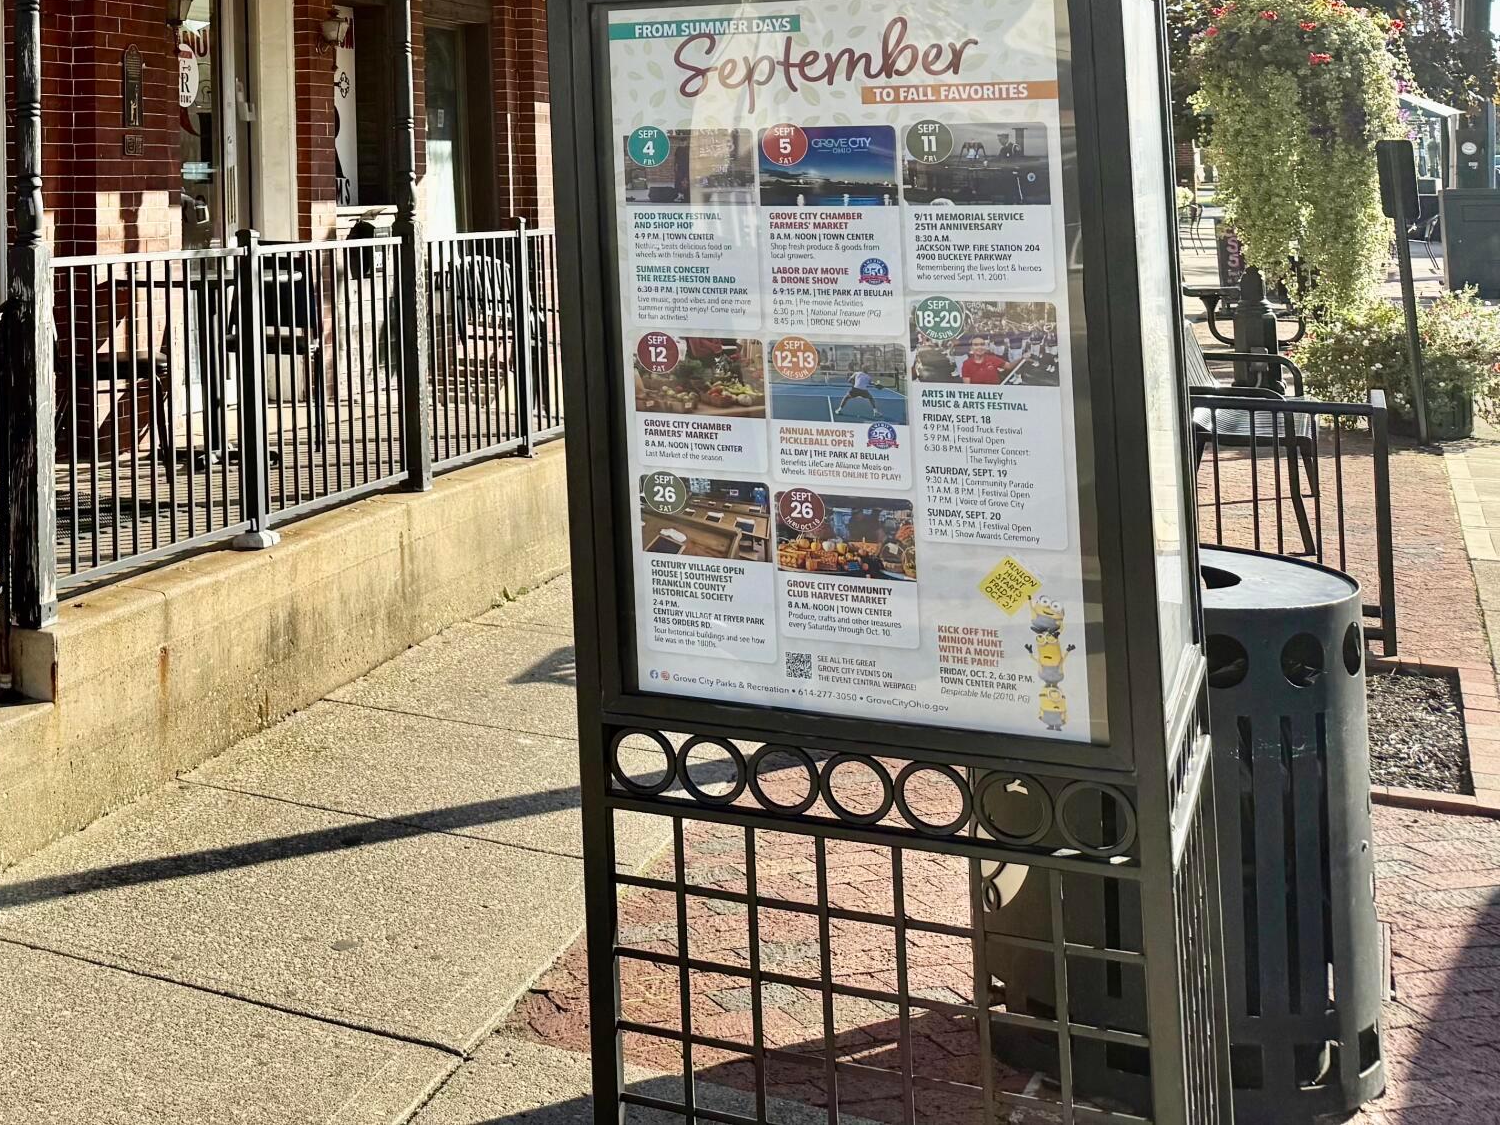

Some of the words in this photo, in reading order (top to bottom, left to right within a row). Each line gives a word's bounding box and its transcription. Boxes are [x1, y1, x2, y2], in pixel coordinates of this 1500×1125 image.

[635, 23, 677, 38] FROM
[681, 20, 748, 35] SUMMER
[752, 18, 791, 32] DAYS
[674, 16, 979, 114] September
[873, 88, 895, 102] TO
[900, 86, 936, 101] FALL
[940, 83, 1028, 100] FAVORITES
[638, 129, 658, 138] SEPT
[774, 127, 795, 136] SEPT
[917, 124, 940, 134] SEPT
[642, 140, 655, 156] 4
[779, 138, 792, 154] 5
[921, 136, 937, 152] 11
[769, 212, 798, 220] GROVE
[799, 212, 818, 220] CITY
[820, 212, 863, 220] CHAMBER
[914, 213, 933, 221] 9/11
[936, 213, 985, 221] MEMORIAL
[987, 213, 1024, 221] SERVICE
[813, 222, 849, 230] MARKET
[915, 223, 937, 231] 25TH
[940, 223, 1003, 231] ANNIVERSARY
[915, 244, 951, 252] JACKSON
[953, 244, 971, 252] TWP.
[673, 266, 710, 274] CONCERT
[771, 267, 800, 275] LABOR
[802, 267, 818, 275] DAY
[821, 267, 849, 276] MOVIE
[916, 264, 965, 272] Remembering
[1018, 264, 1042, 272] heroes
[772, 276, 778, 284] &
[780, 276, 810, 284] DRONE
[812, 277, 839, 285] SHOW
[927, 300, 950, 310] SEPT
[916, 310, 960, 328] 18-20
[647, 336, 668, 345] SEPT
[784, 341, 805, 350] SEPT
[649, 347, 667, 362] 12
[774, 351, 815, 368] 12-13
[921, 389, 944, 398] ARTS
[946, 390, 955, 398] IN
[958, 391, 975, 399] THE
[977, 391, 1003, 400] ALLEY
[922, 400, 951, 408] MUSIC
[953, 401, 960, 409] &
[962, 401, 985, 410] ARTS
[987, 402, 1028, 411] FESTIVAL
[923, 413, 954, 423] FRIDAY,
[956, 415, 978, 424] SEPT.
[981, 416, 991, 424] 18
[644, 419, 670, 428] GROVE
[672, 420, 690, 429] CITY
[691, 421, 732, 431] CHAMBER
[644, 428, 684, 438] FARMERS'
[685, 430, 718, 440] MARKET
[779, 427, 814, 436] ANNUAL
[816, 428, 855, 438] MAYOR'S
[780, 436, 829, 447] PICKLEBALL
[831, 439, 854, 448] OPEN
[925, 466, 970, 476] SATURDAY,
[973, 468, 995, 477] SEPT.
[997, 469, 1008, 477] 19
[654, 475, 674, 484] SEPT
[653, 486, 676, 503] 26
[791, 491, 812, 501] SEPT
[790, 502, 814, 518] 26
[927, 508, 964, 519] SUNDAY,
[966, 510, 988, 520] SEPT.
[990, 512, 1001, 520] 20
[651, 559, 687, 569] CENTURY
[688, 563, 721, 573] VILLAGE
[722, 566, 745, 575] OPEN
[651, 569, 678, 579] HOUSE
[684, 572, 733, 583] SOUTHWEST
[1004, 559, 1037, 588] MINION
[1004, 570, 1026, 589] HUNT
[652, 578, 692, 588] FRANKLIN
[694, 581, 726, 592] COUNTY
[787, 579, 815, 590] GROVE
[817, 582, 836, 591] CITY
[837, 584, 893, 596] COMMUNITY
[995, 573, 1022, 597] STARTS
[652, 587, 699, 599] HISTORICAL
[701, 592, 733, 602] SOCIETY
[787, 589, 809, 598] CLUB
[811, 591, 850, 602] HARVEST
[851, 595, 887, 605] MARKET
[989, 579, 1018, 604] FRIDAY
[938, 625, 959, 634] KICK
[962, 627, 979, 636] OFF
[981, 629, 999, 638] THE
[938, 635, 975, 646] MINION
[977, 638, 1003, 648] HUNT
[939, 645, 963, 654] WITH
[965, 647, 972, 655] A
[974, 648, 1005, 658] MOVIE
[939, 655, 949, 663] IN
[951, 656, 969, 665] THE
[971, 658, 999, 667] PARK!
[940, 676, 964, 685] TOWN
[966, 678, 994, 689] CENTER
[996, 682, 1017, 691] PARK
[673, 674, 697, 684] Grove
[698, 676, 714, 687] City
[716, 678, 737, 688] Parks
[738, 681, 745, 689] &
[746, 682, 790, 694] Recreation
[798, 688, 857, 702] 614-277-3050
[866, 695, 949, 713] GroveCityOhio.gov
